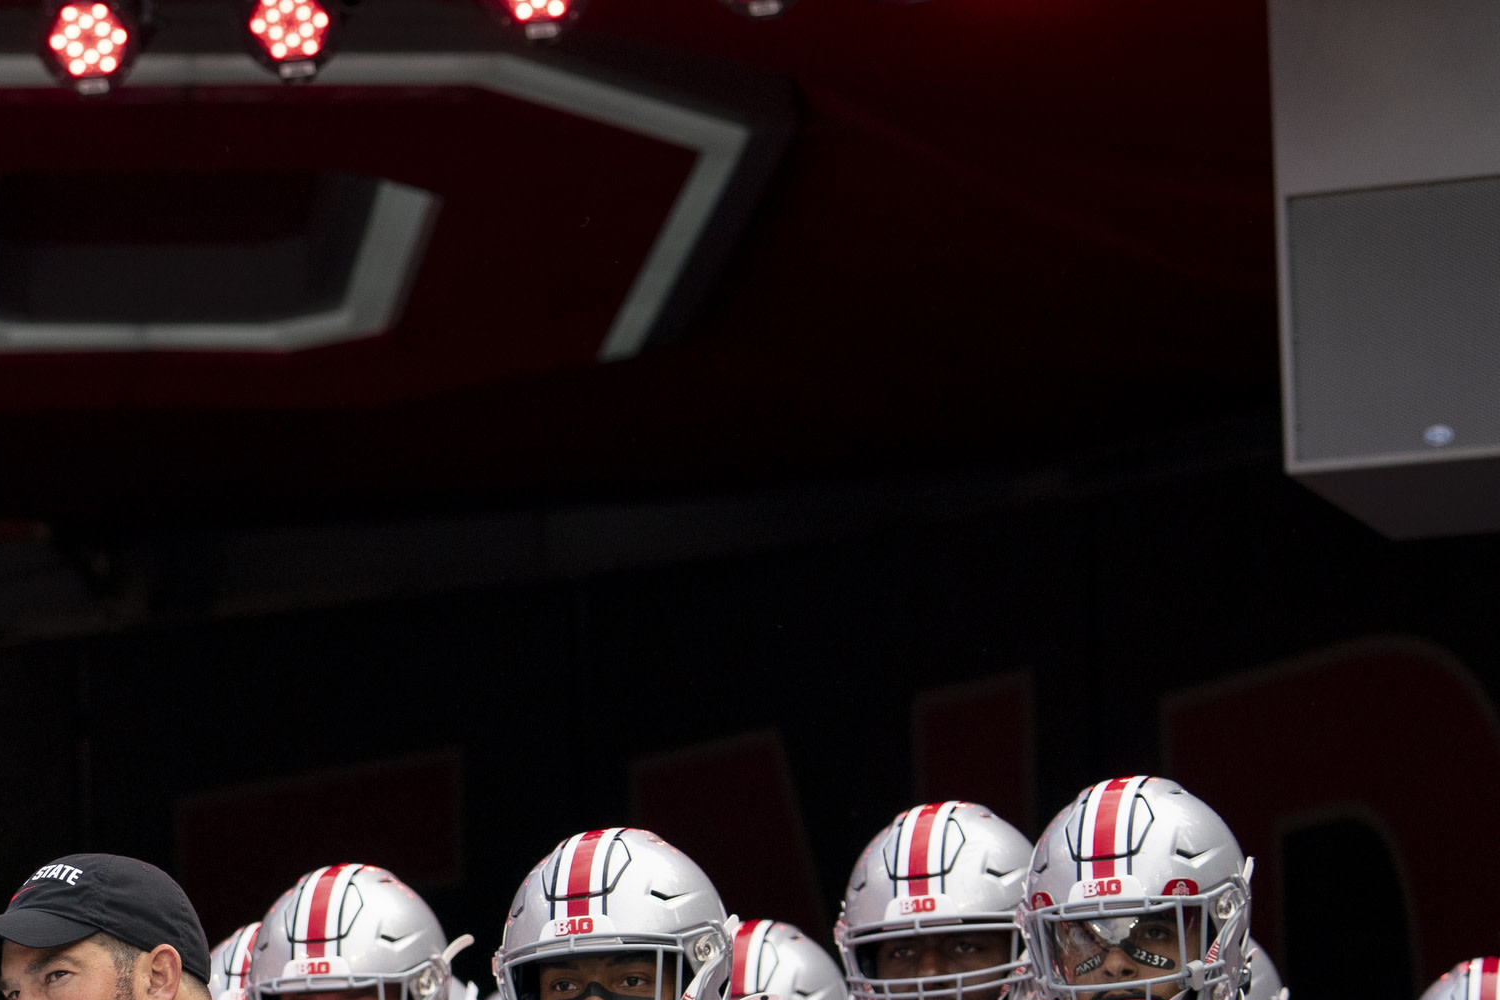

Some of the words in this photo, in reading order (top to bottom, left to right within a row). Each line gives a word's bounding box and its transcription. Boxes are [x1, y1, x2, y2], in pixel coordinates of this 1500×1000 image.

[32, 863, 83, 886] STATE
[555, 917, 594, 937] B1G
[1133, 949, 1168, 967] 22:37
